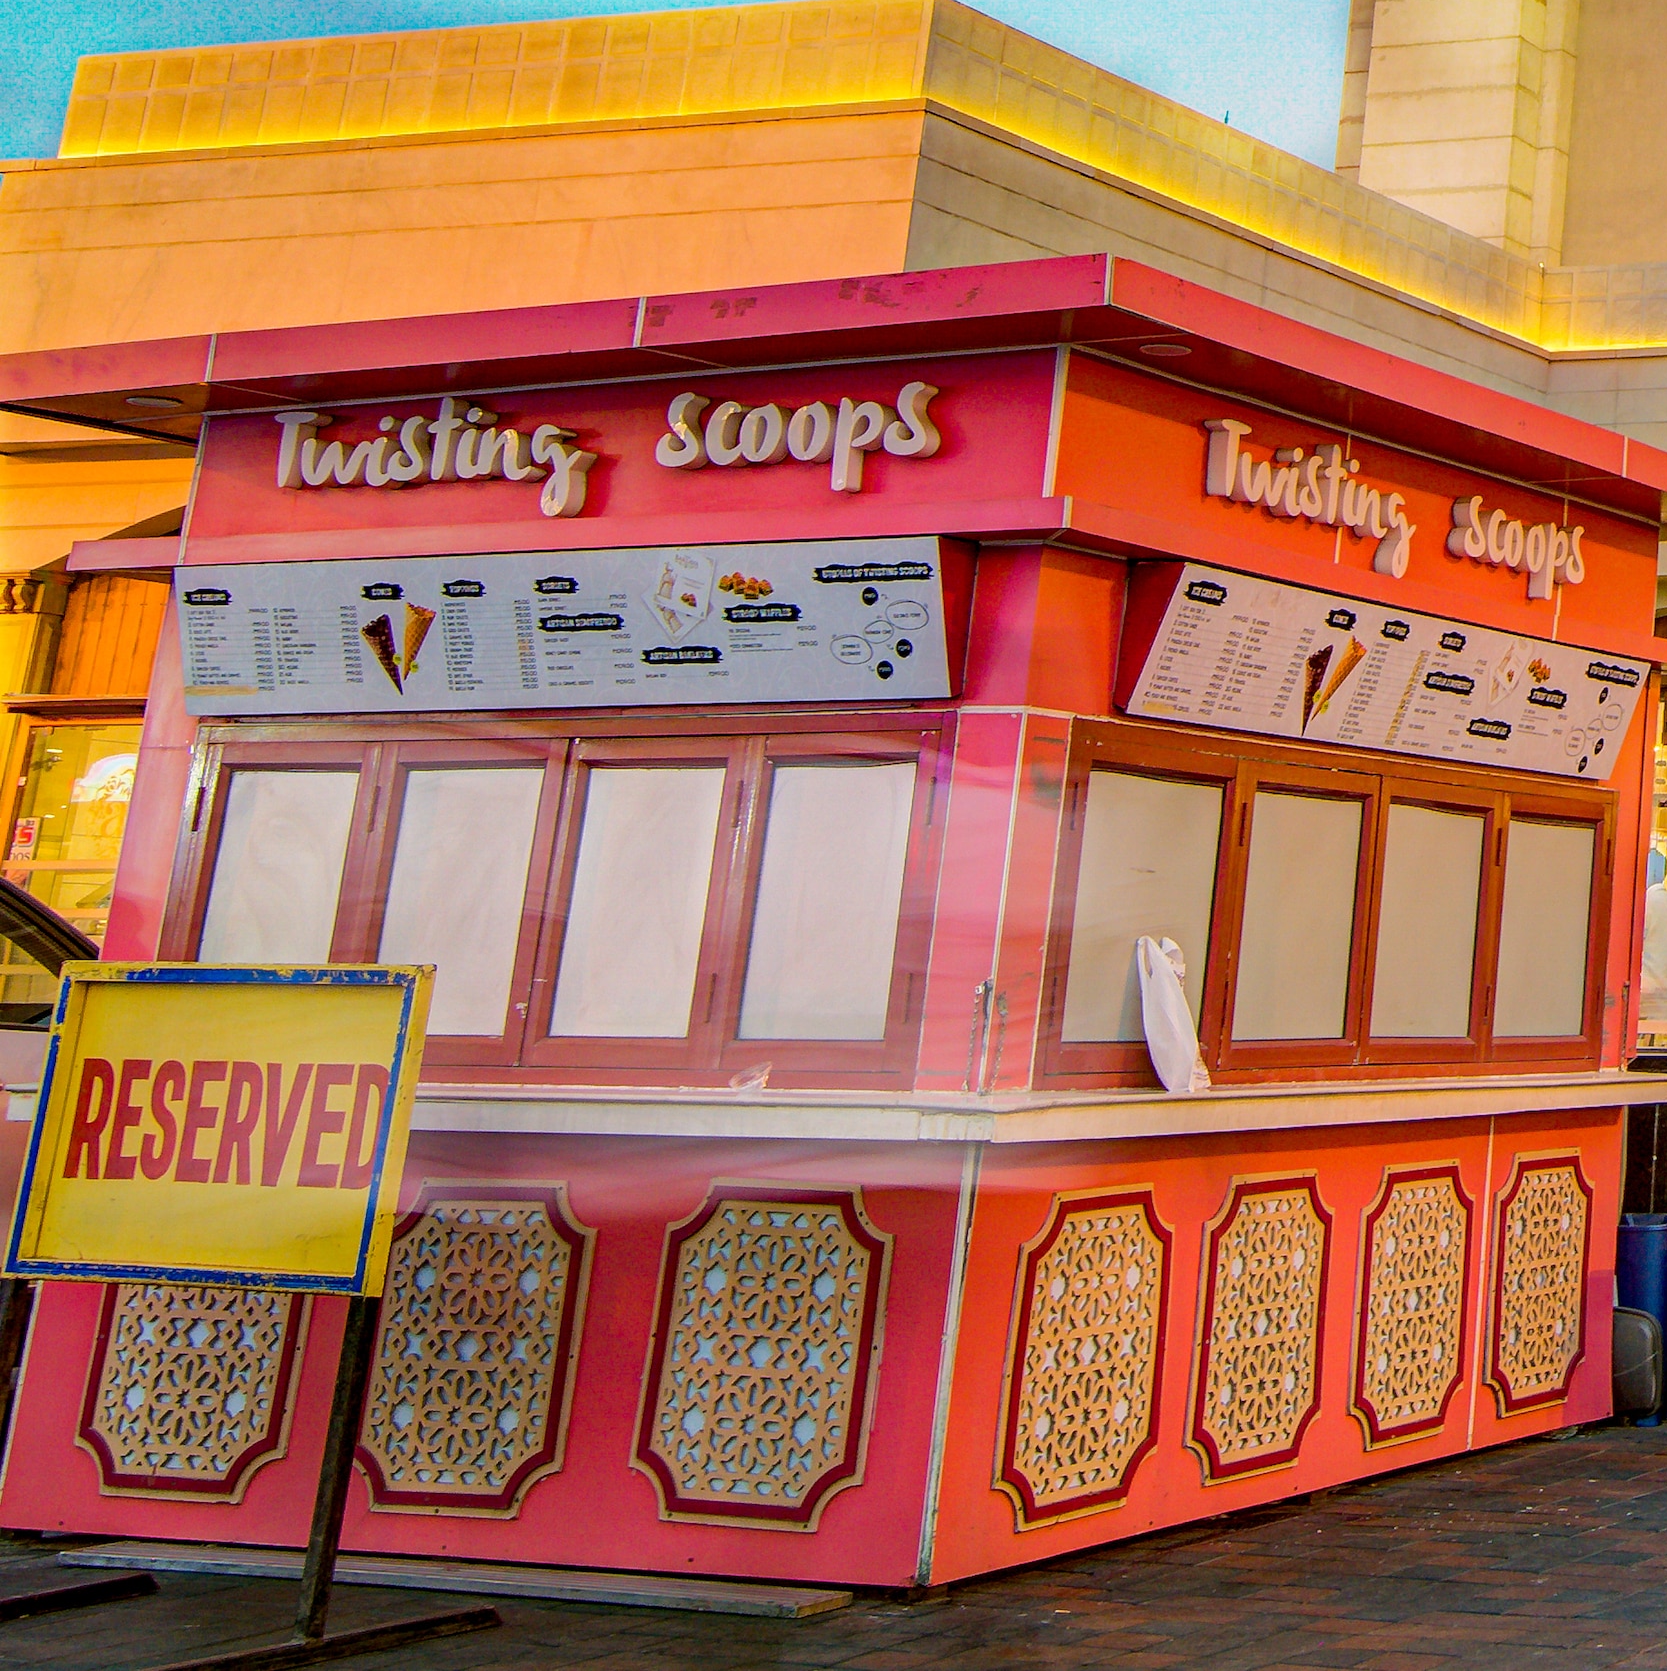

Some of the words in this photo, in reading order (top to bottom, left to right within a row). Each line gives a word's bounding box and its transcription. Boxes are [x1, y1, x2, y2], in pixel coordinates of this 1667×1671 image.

[274, 397, 597, 517] Twisting
[1204, 418, 1416, 579] Twisting
[62, 1057, 391, 1190] RESERVED
